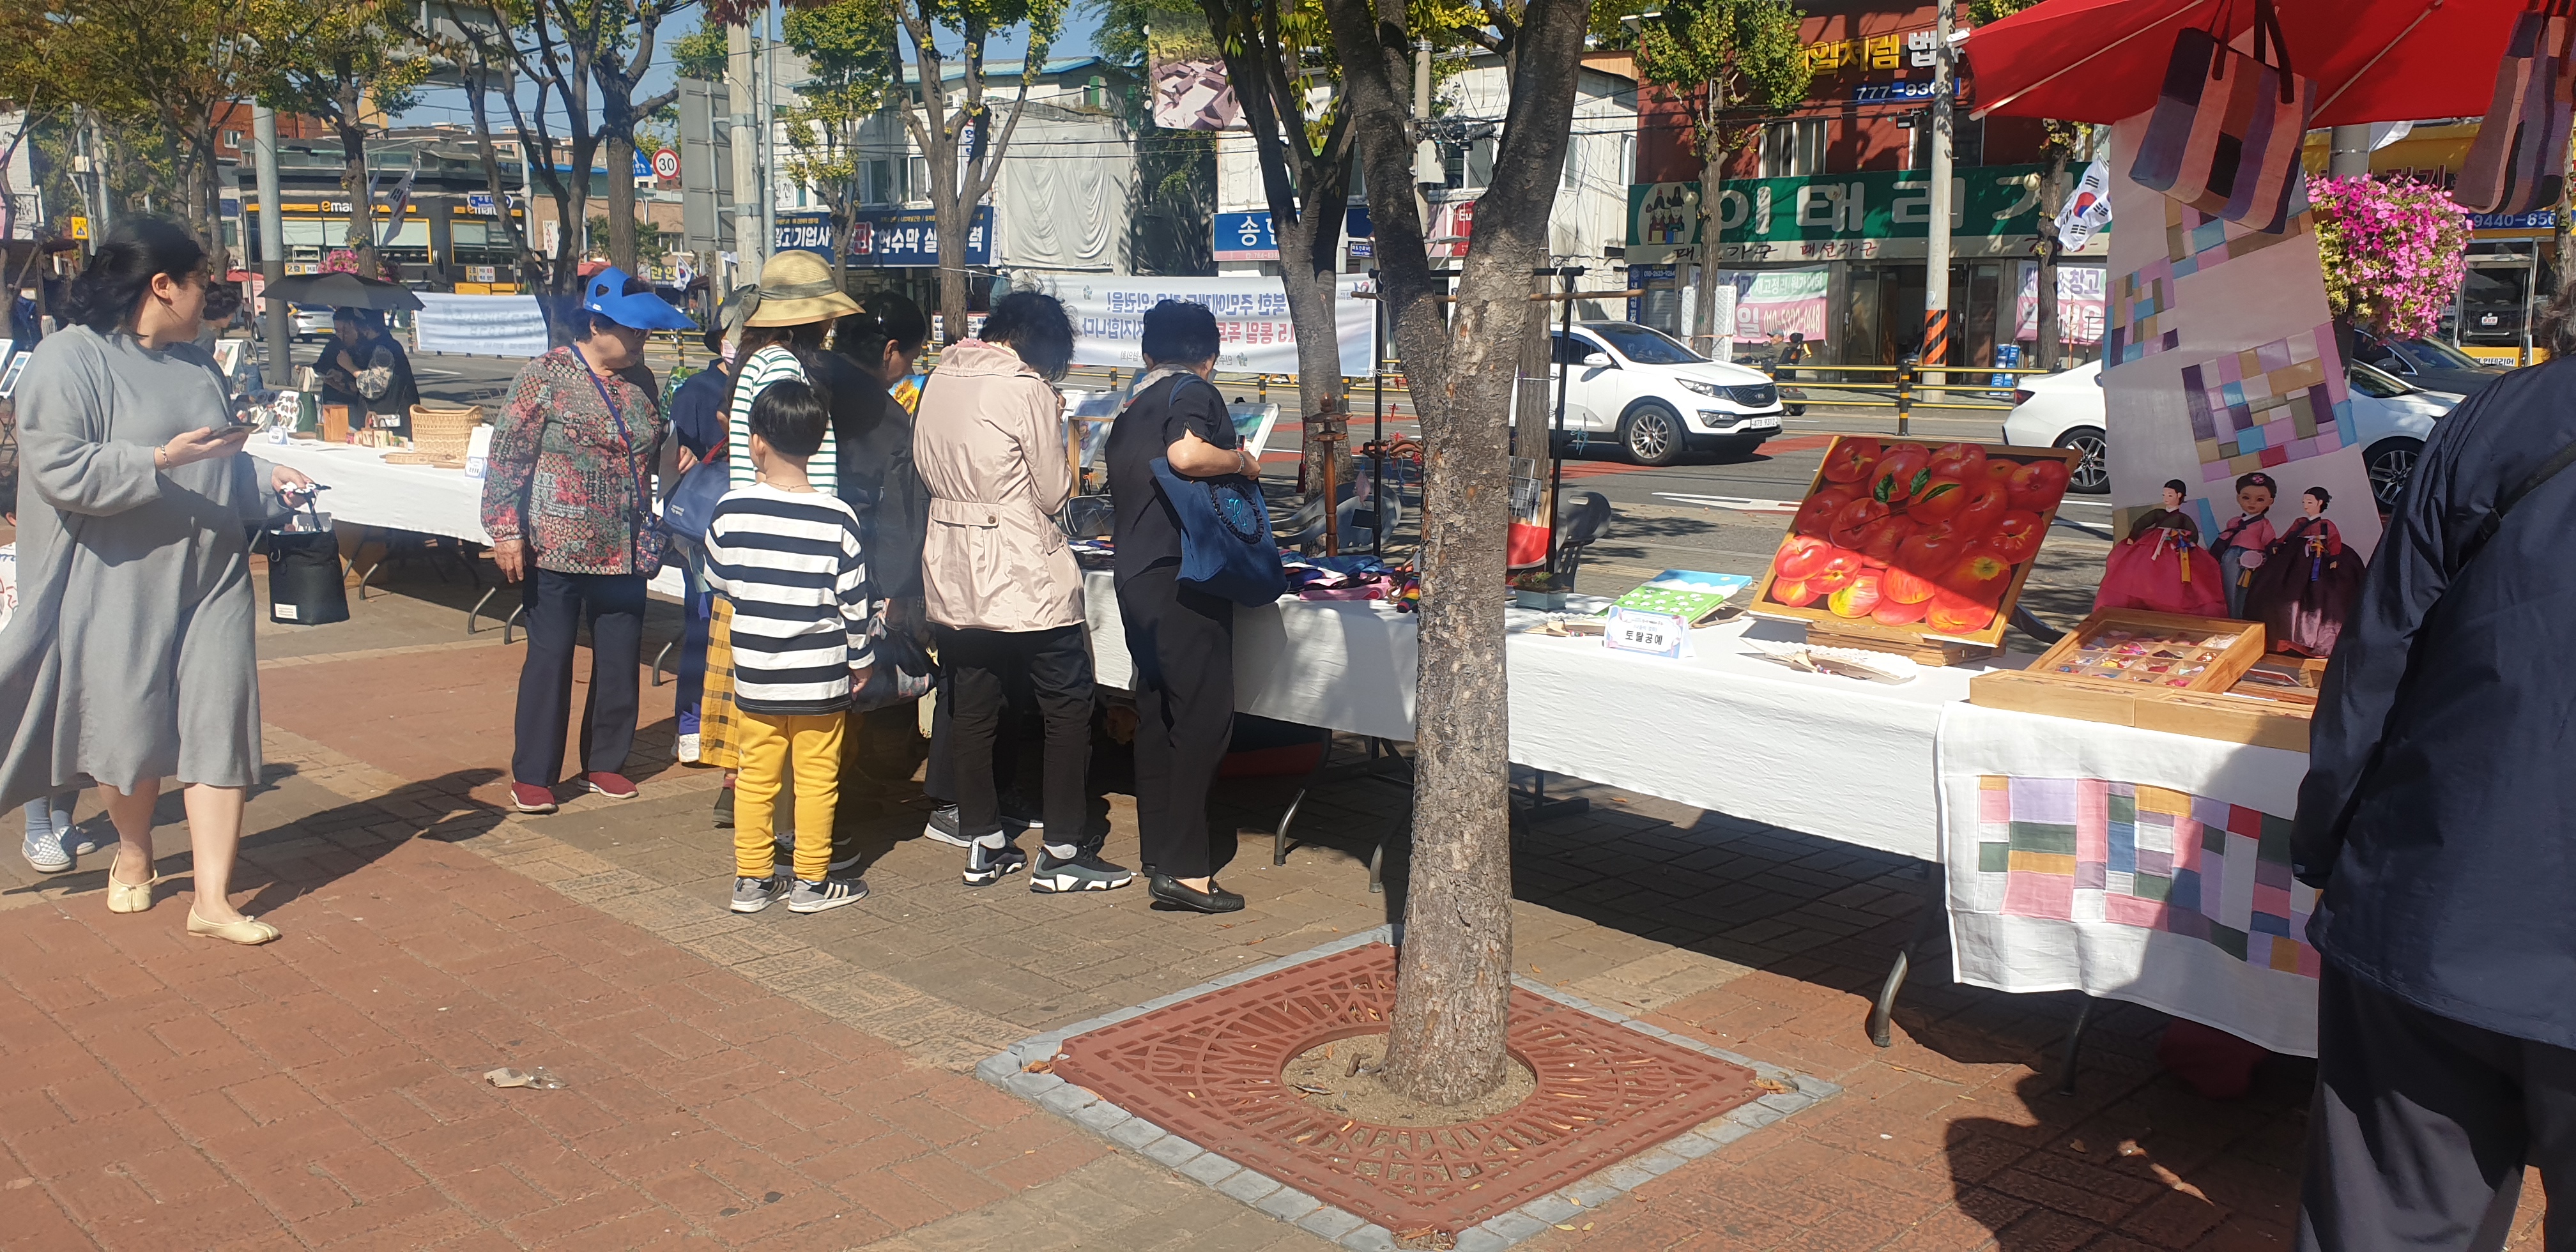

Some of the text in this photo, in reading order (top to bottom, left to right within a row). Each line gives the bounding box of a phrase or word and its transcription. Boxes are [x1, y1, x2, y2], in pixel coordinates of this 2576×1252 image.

[1856, 82, 1951, 100] 777-936
[659, 158, 675, 171] 30
[878, 227, 920, 254] 현수막
[1800, 241, 1877, 258] 패션가구
[2069, 269, 2099, 294] 창고
[1625, 630, 1662, 645] 토탈공예
